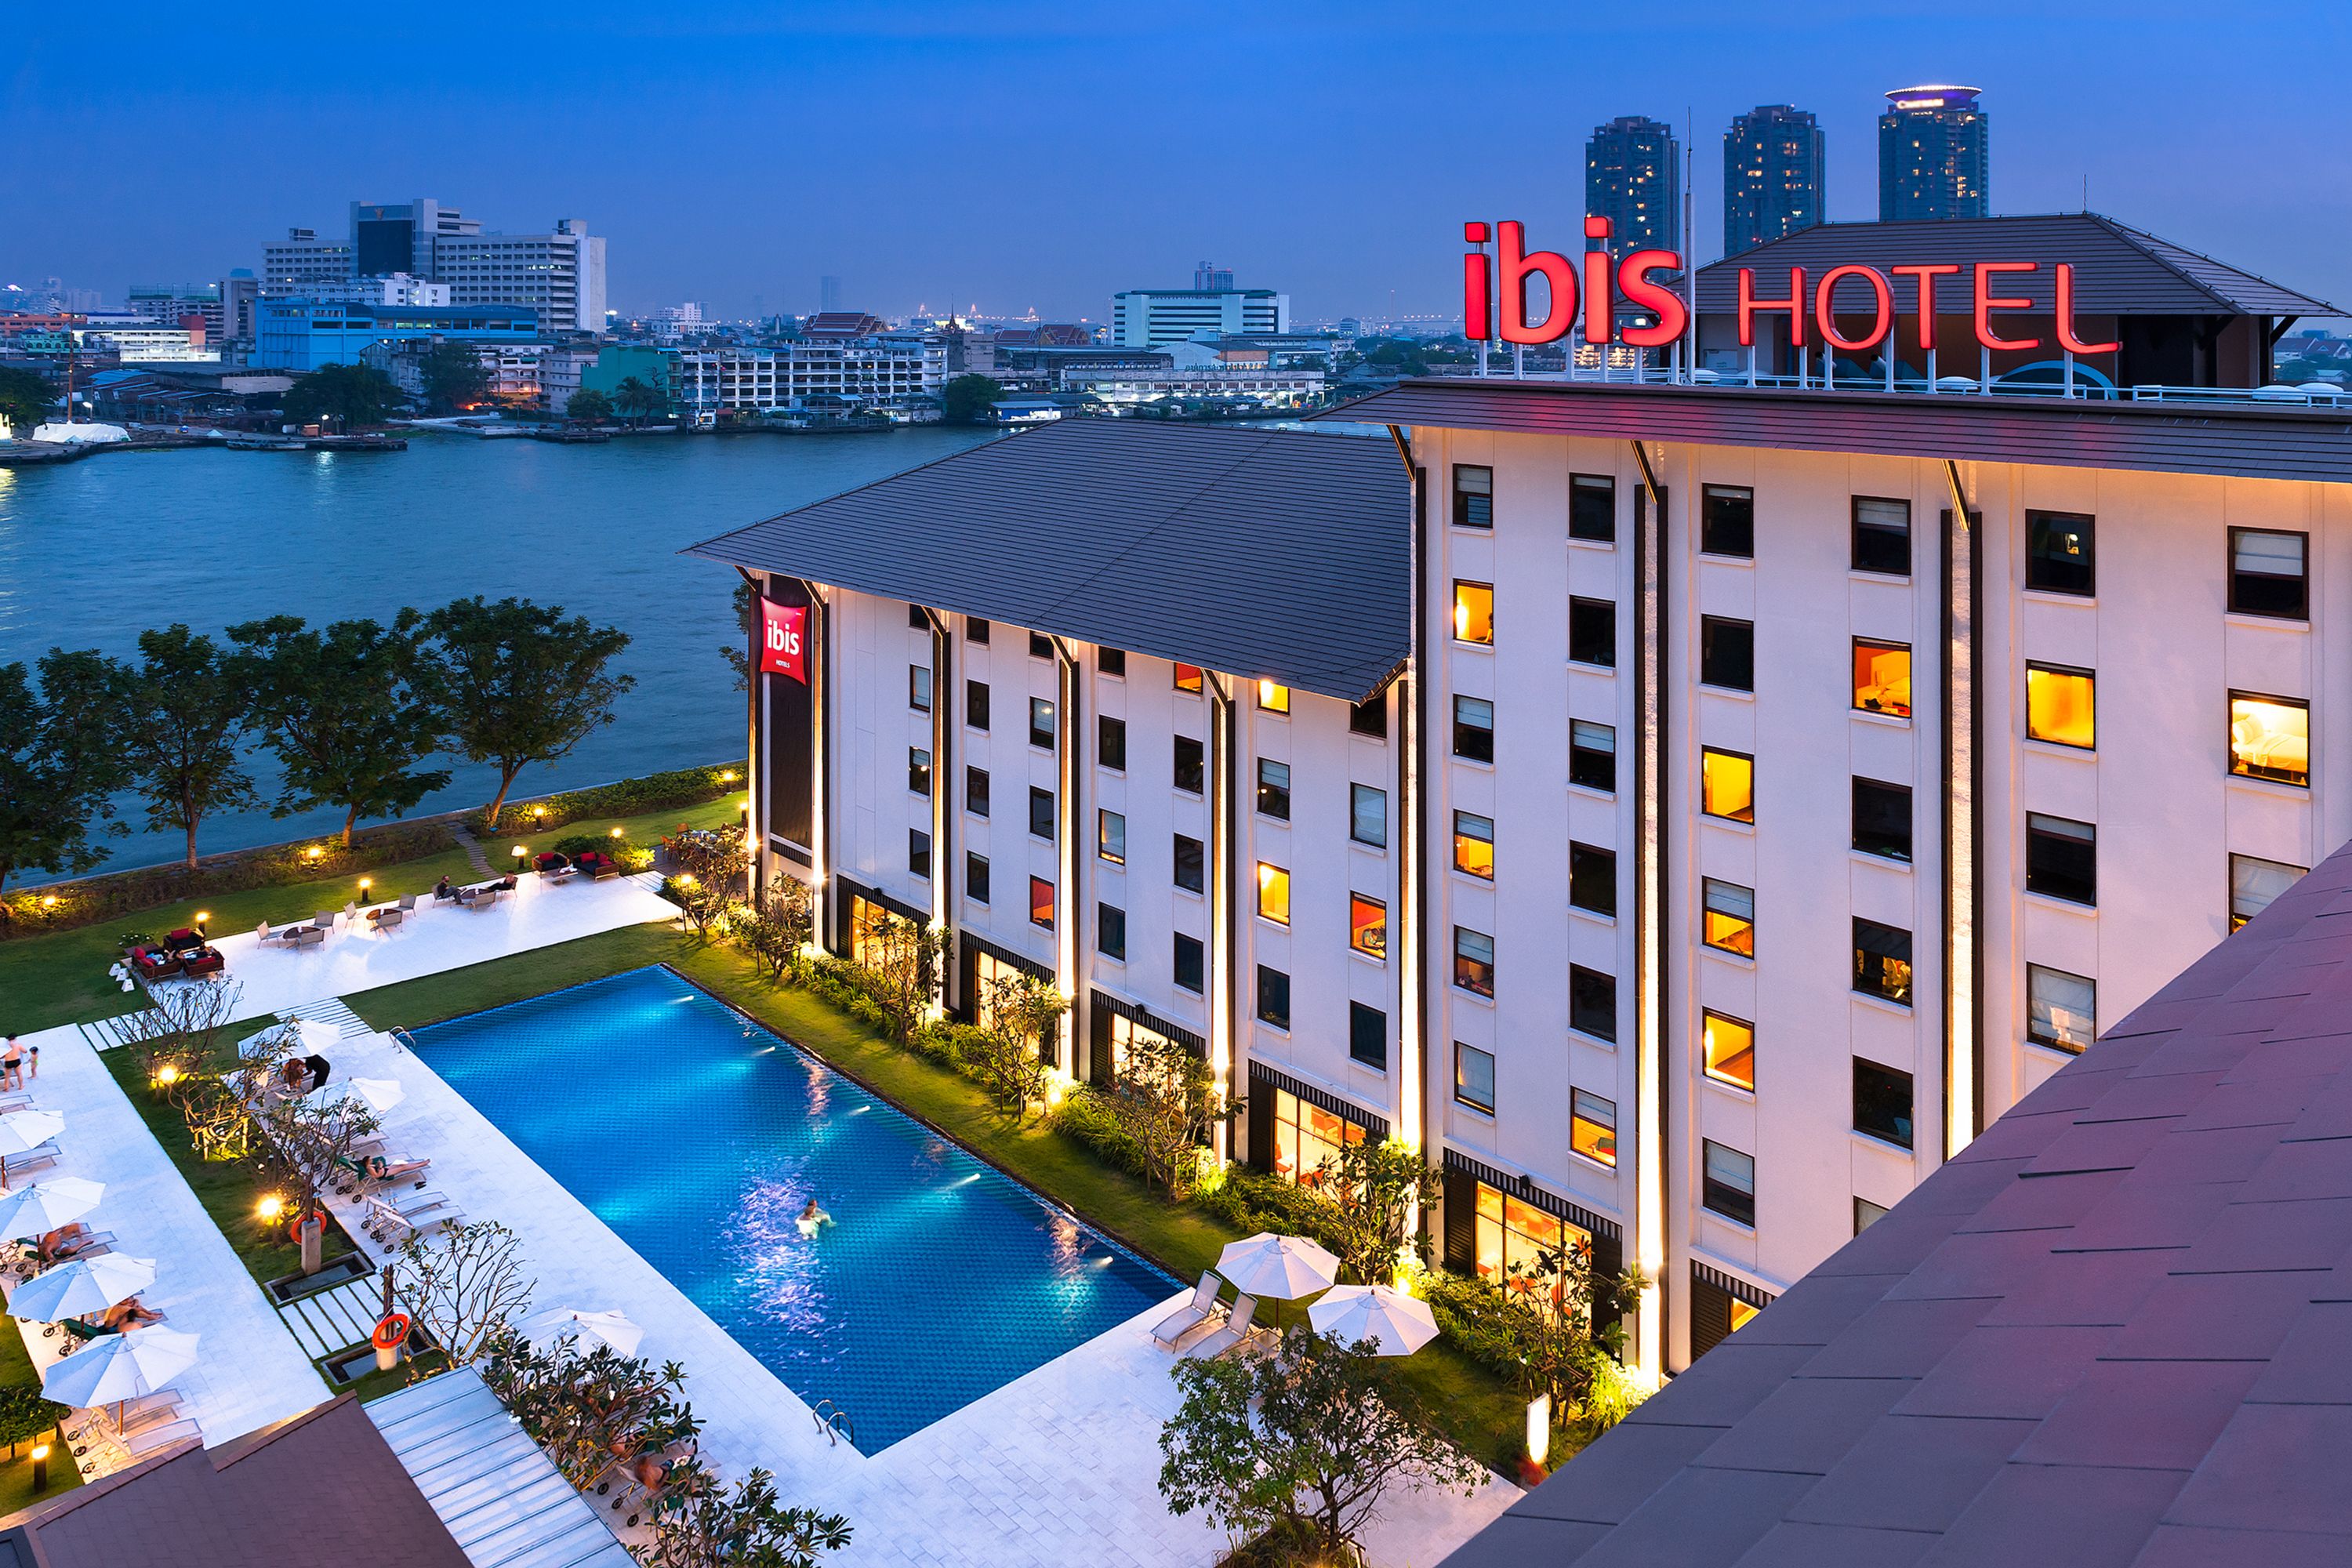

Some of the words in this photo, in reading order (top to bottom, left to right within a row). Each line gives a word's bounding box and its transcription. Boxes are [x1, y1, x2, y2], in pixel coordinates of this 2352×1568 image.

[1465, 216, 1690, 347] ibis
[1738, 262, 2123, 354] HOTEL
[768, 620, 800, 655] ibis
